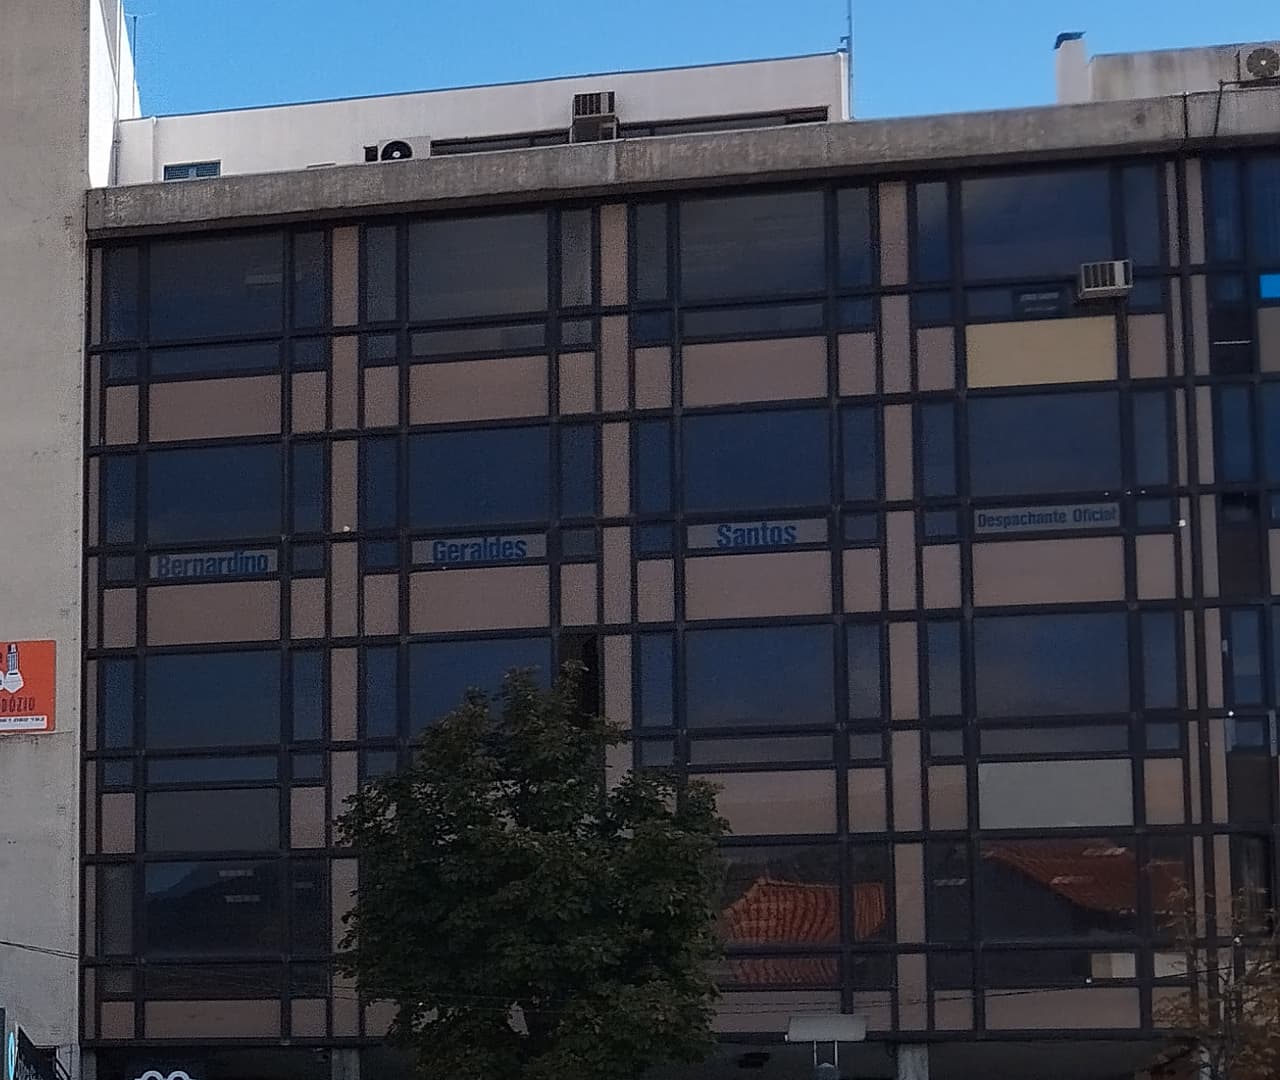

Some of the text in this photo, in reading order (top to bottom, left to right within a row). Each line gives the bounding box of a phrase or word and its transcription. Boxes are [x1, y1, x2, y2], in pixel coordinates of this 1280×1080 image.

[716, 522, 797, 546] Santos
[432, 537, 527, 562] Geraldes
[157, 551, 269, 578] Bernardino
